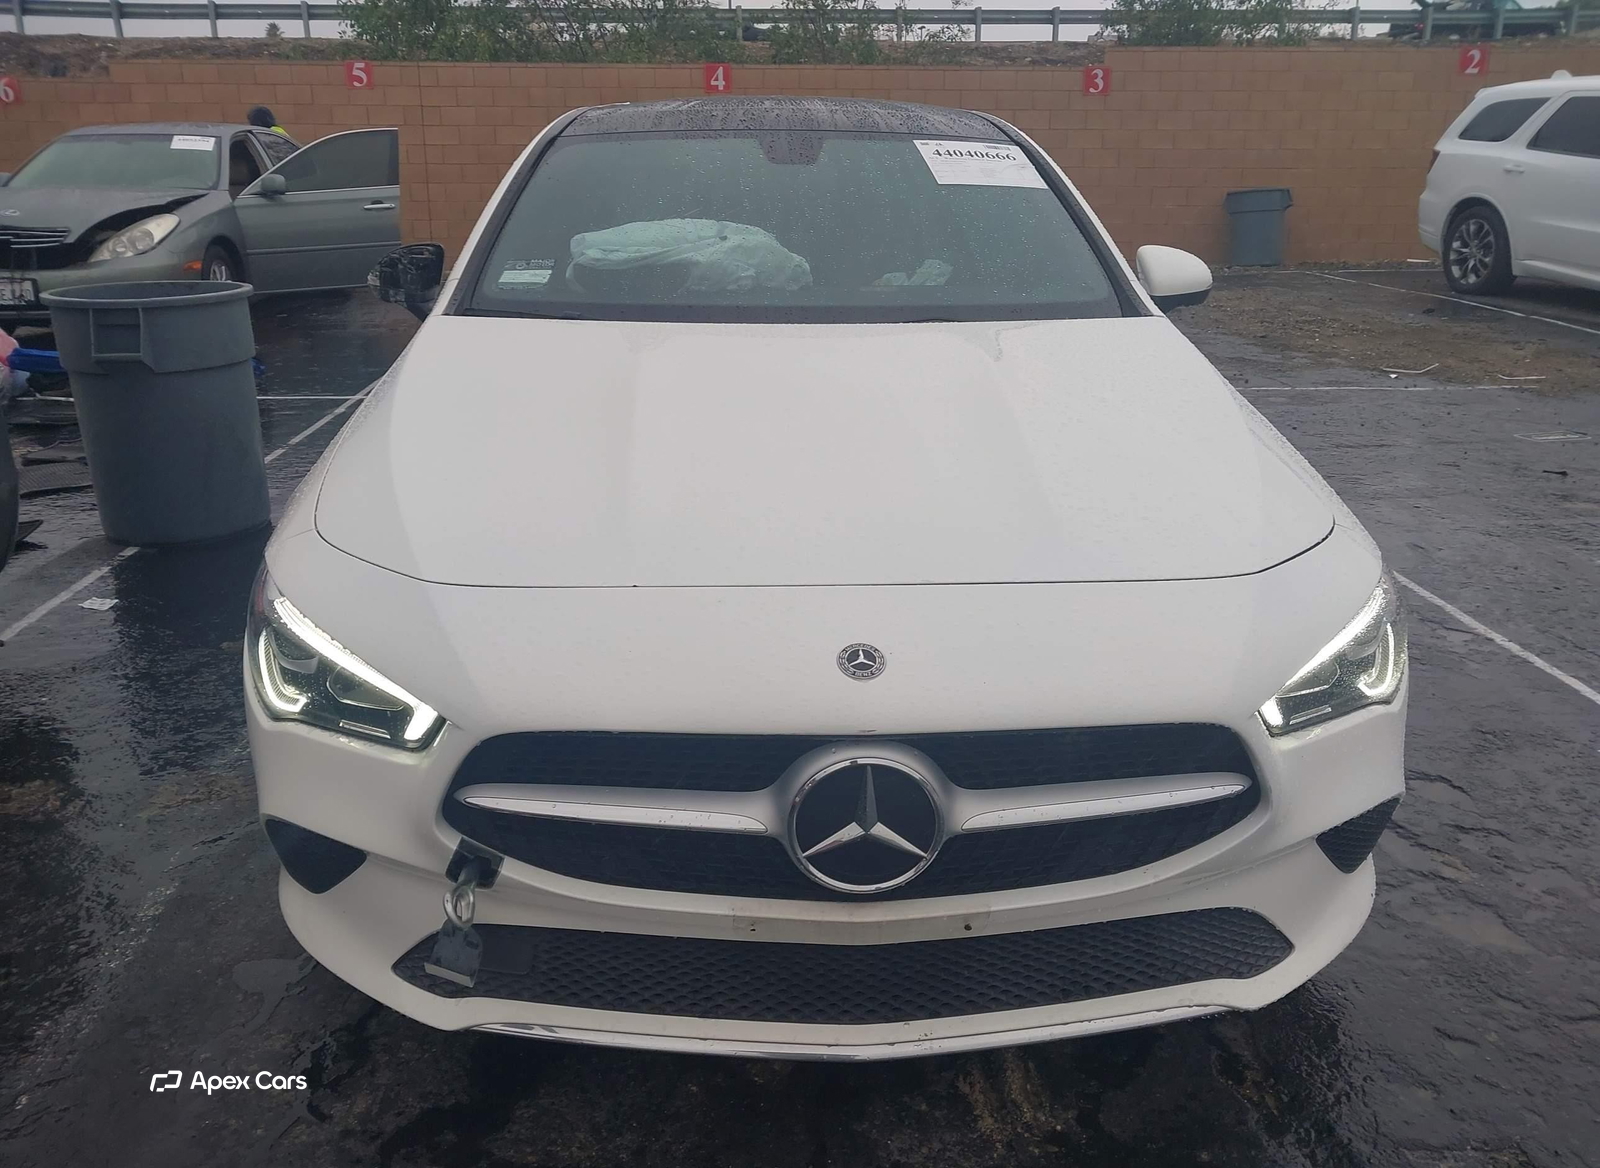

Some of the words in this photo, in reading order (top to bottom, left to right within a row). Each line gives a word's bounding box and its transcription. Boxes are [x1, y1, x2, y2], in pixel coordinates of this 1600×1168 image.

[1464, 49, 1481, 73] 2
[352, 62, 367, 87] 5
[710, 66, 726, 90] 4
[1089, 69, 1104, 93] 3
[0, 77, 15, 104] 6
[932, 148, 1017, 161] 44040666
